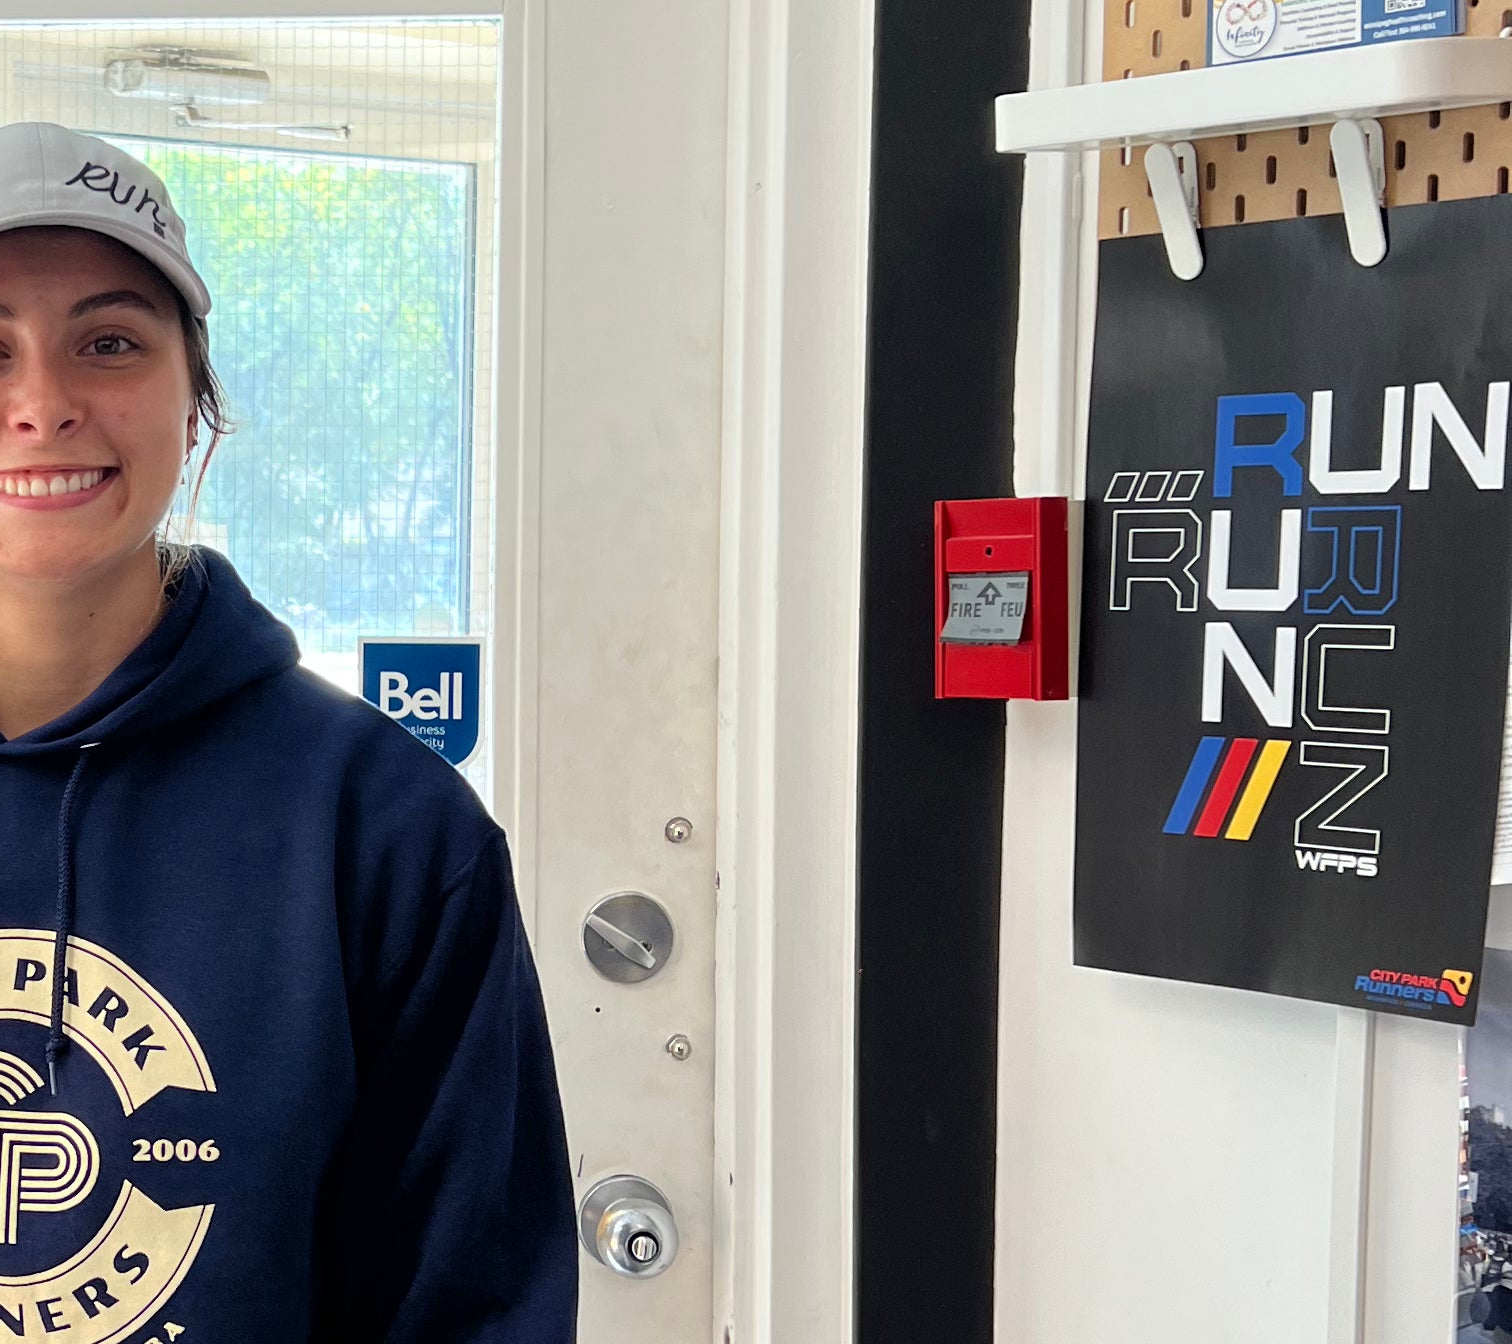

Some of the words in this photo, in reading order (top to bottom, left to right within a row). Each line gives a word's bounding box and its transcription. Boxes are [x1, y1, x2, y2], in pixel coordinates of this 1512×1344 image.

[1211, 380, 1511, 498] RUN
[951, 602, 982, 618] FIRE
[1000, 601, 1024, 617] FEU
[380, 671, 463, 720] Bell
[1294, 849, 1379, 878] WFPS
[1354, 975, 1435, 1003] Runners
[1370, 969, 1400, 983] CITY
[1401, 973, 1439, 989] PARK
[13, 958, 168, 1072] PARK
[132, 1139, 220, 1163] 2006
